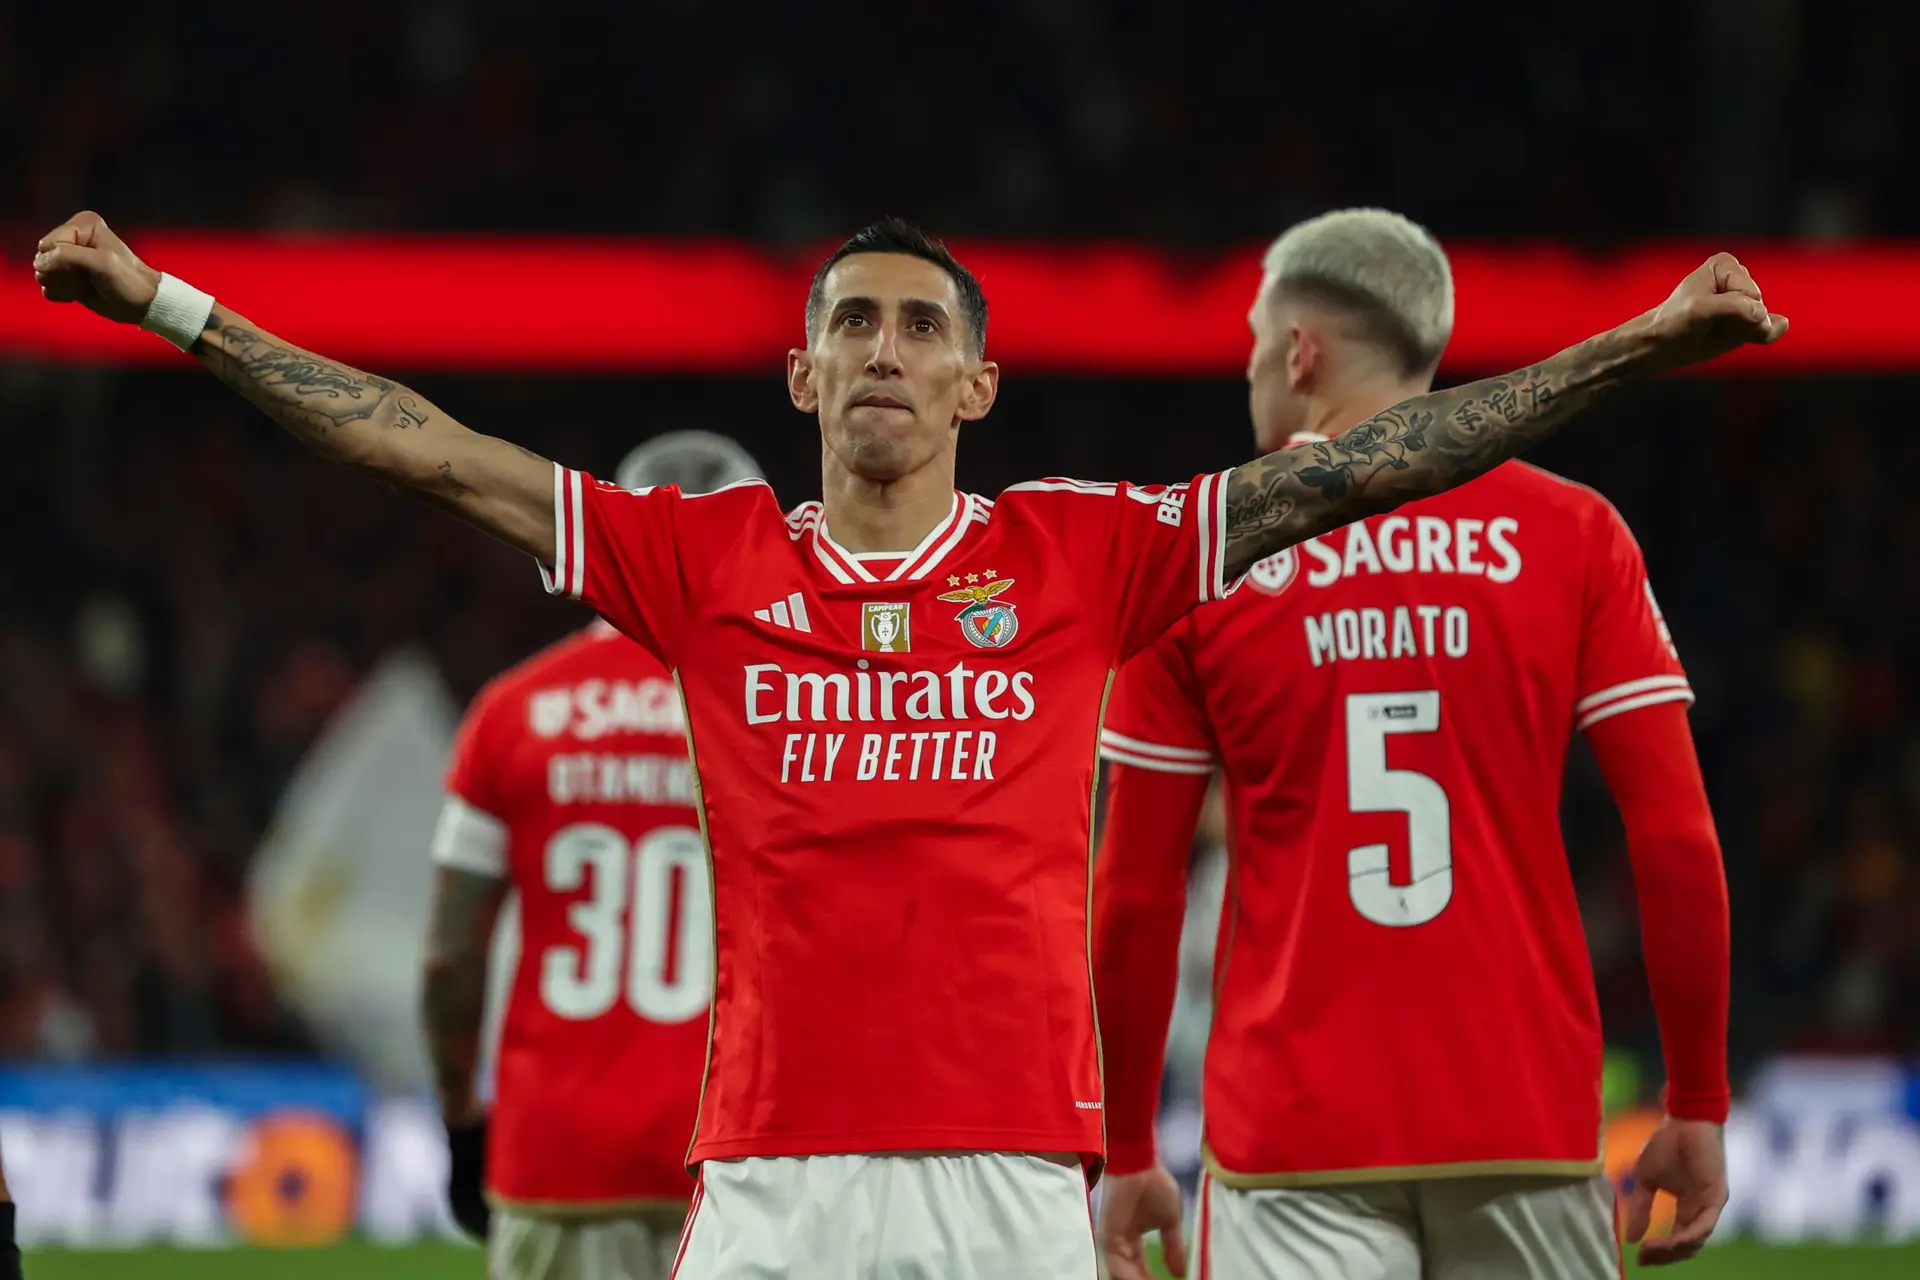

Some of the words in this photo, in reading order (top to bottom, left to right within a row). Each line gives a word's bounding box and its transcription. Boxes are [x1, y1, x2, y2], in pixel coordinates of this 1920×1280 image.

[1303, 515, 1523, 588] SAGRES
[1304, 605, 1469, 668] MORATO
[744, 659, 1035, 725] Emirates
[781, 733, 845, 784] FLY
[856, 731, 997, 782] BETTER
[1346, 689, 1454, 928] 5
[540, 822, 714, 1024] 30
